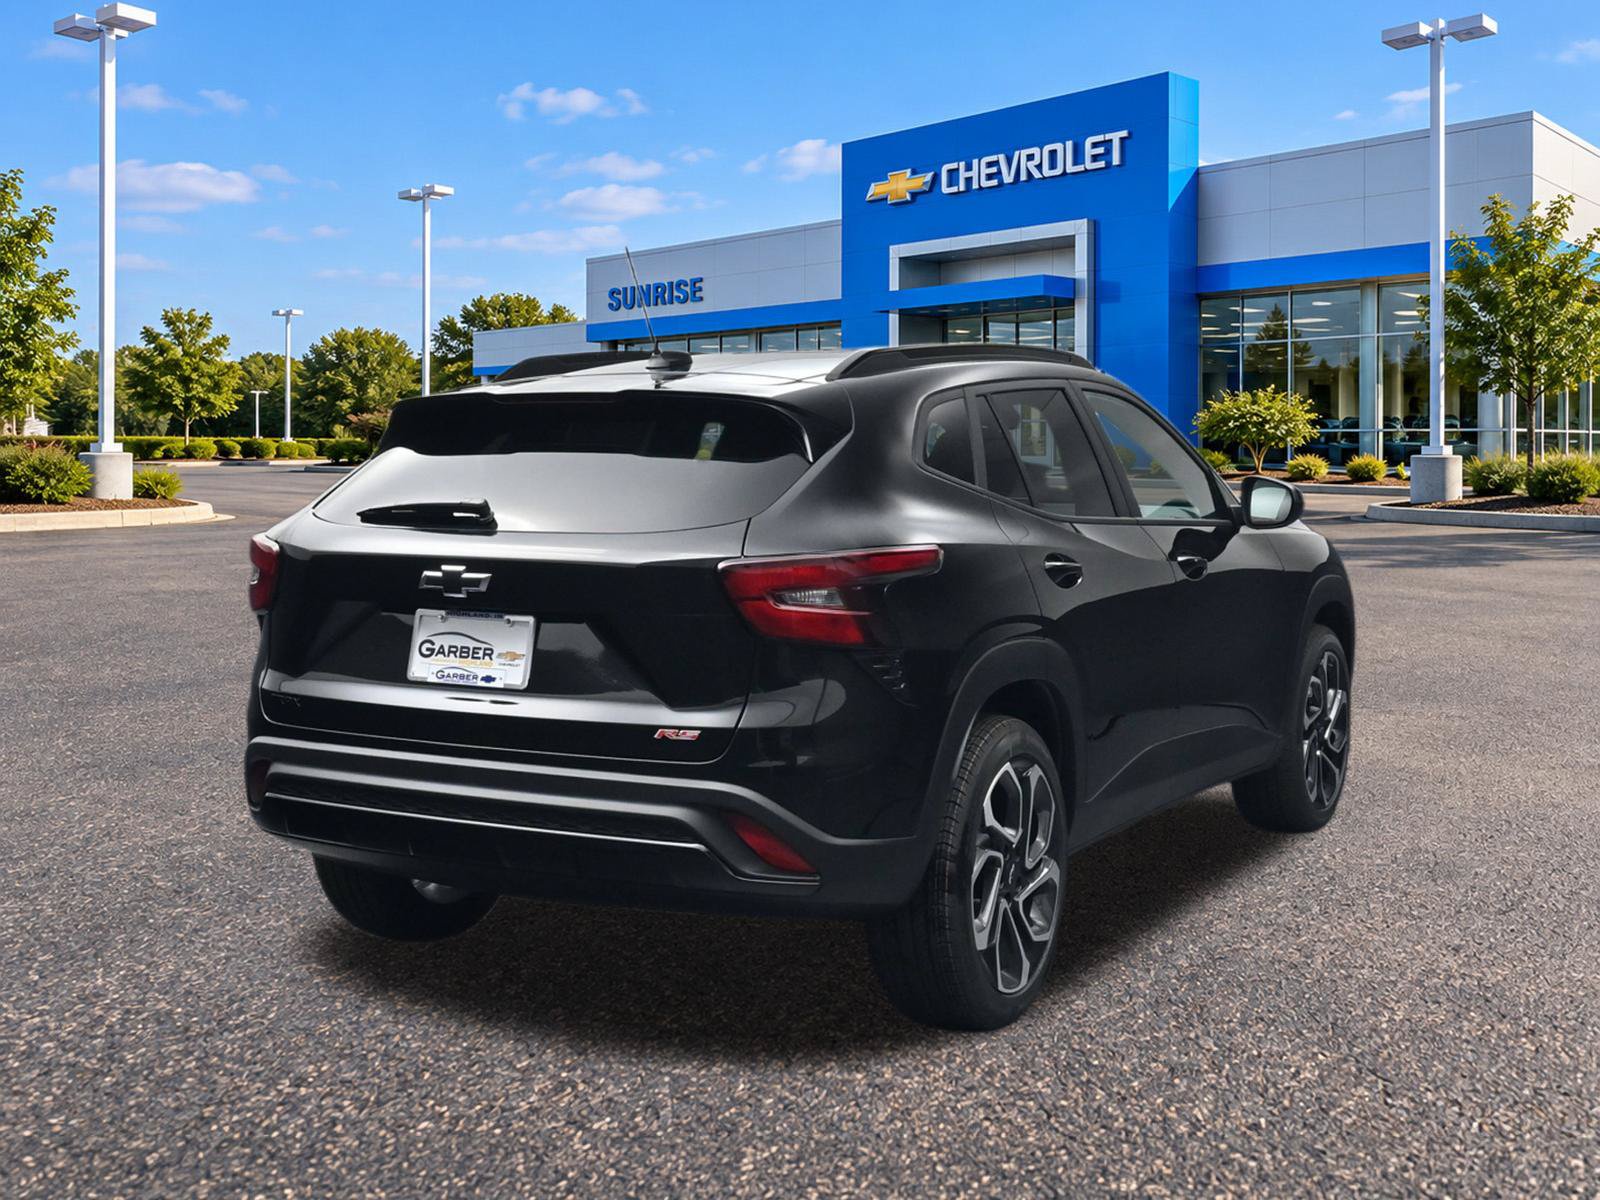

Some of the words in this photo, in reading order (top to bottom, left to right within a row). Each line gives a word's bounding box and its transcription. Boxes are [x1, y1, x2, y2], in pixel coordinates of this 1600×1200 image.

[941, 130, 1129, 195] CHEVROLET
[608, 277, 704, 312] SUNRISE
[418, 639, 495, 661] GARBER
[435, 669, 479, 681] GARBER
[653, 728, 702, 741] RS
